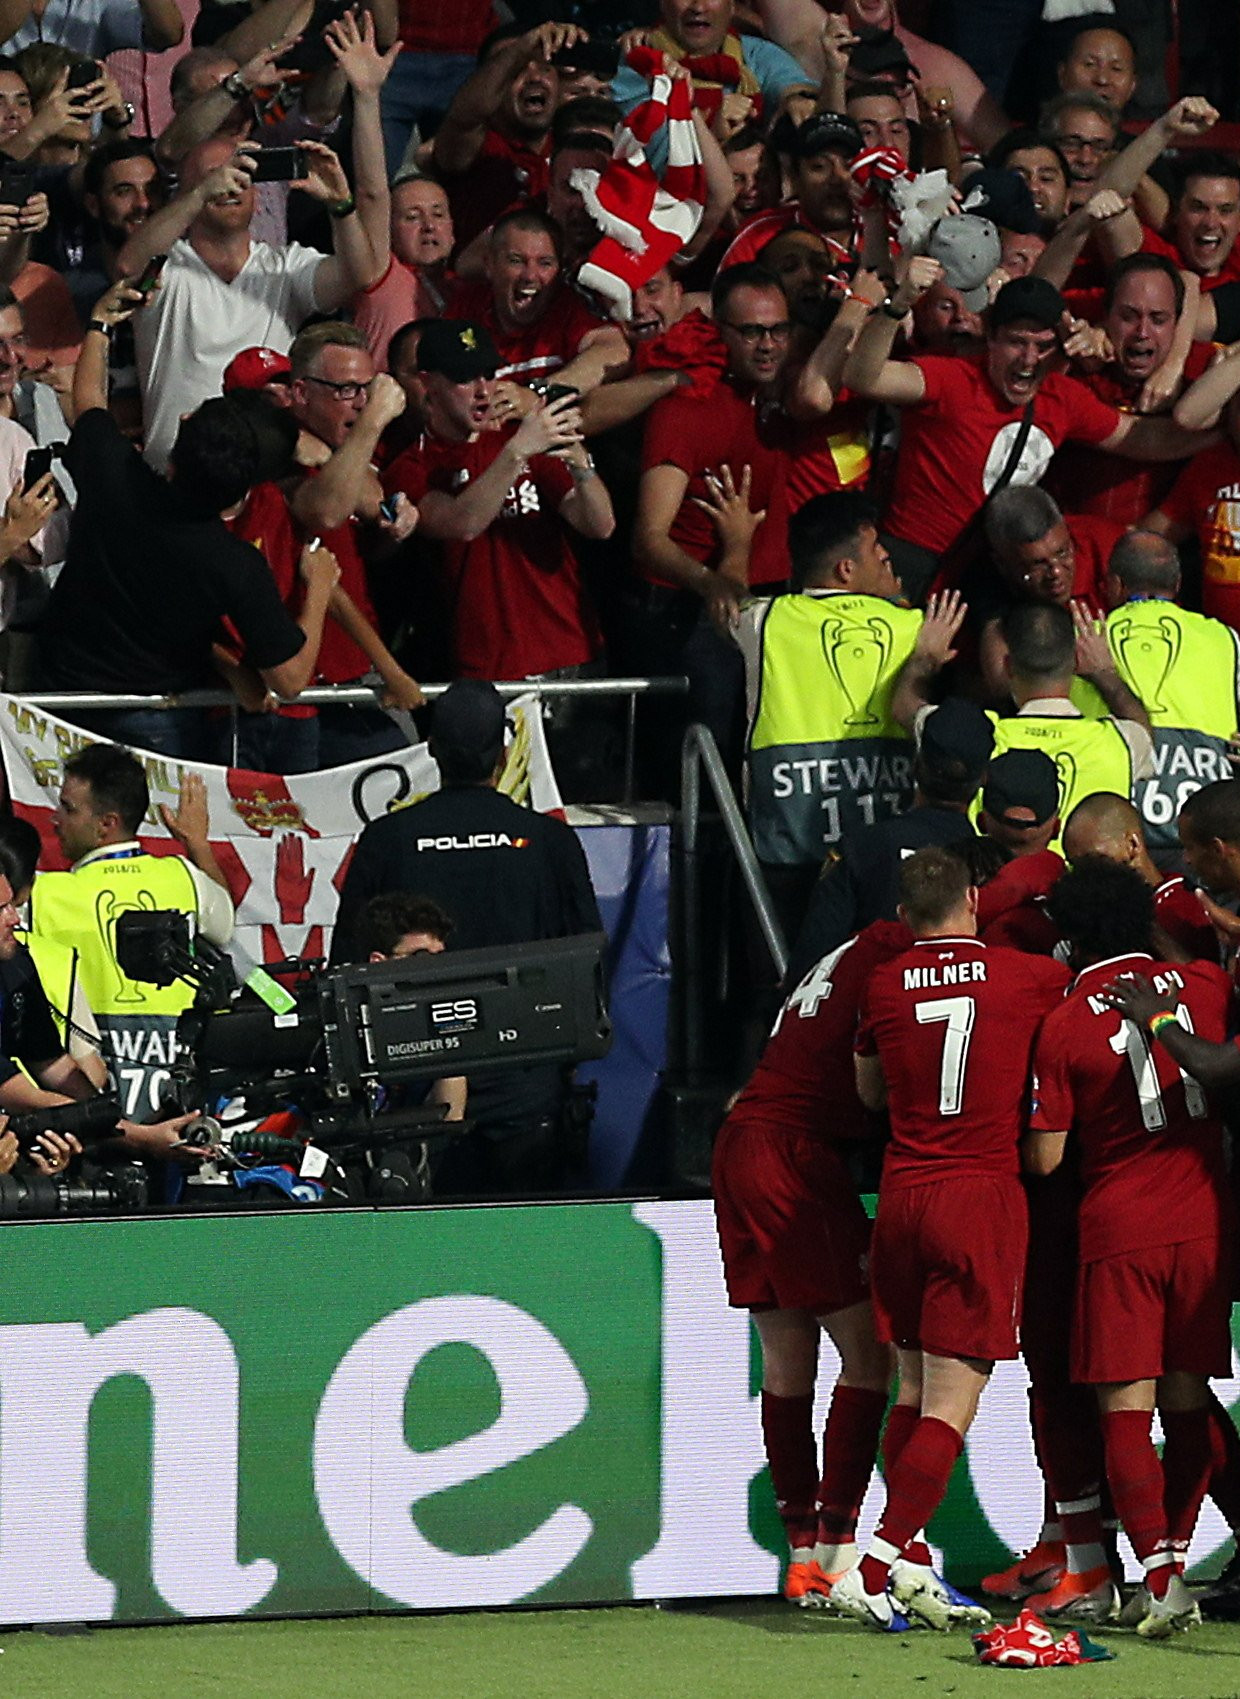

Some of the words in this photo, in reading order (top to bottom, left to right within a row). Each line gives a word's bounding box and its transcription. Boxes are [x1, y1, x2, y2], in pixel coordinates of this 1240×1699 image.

[772, 756, 913, 798] STEWAR
[417, 833, 512, 852] POLICIA
[904, 961, 986, 990] MILNER
[431, 1000, 478, 1023] ES
[387, 1037, 444, 1056] DIGISUPER
[446, 1036, 460, 1048] 95
[499, 1029, 518, 1041] HD
[915, 996, 975, 1116] 7
